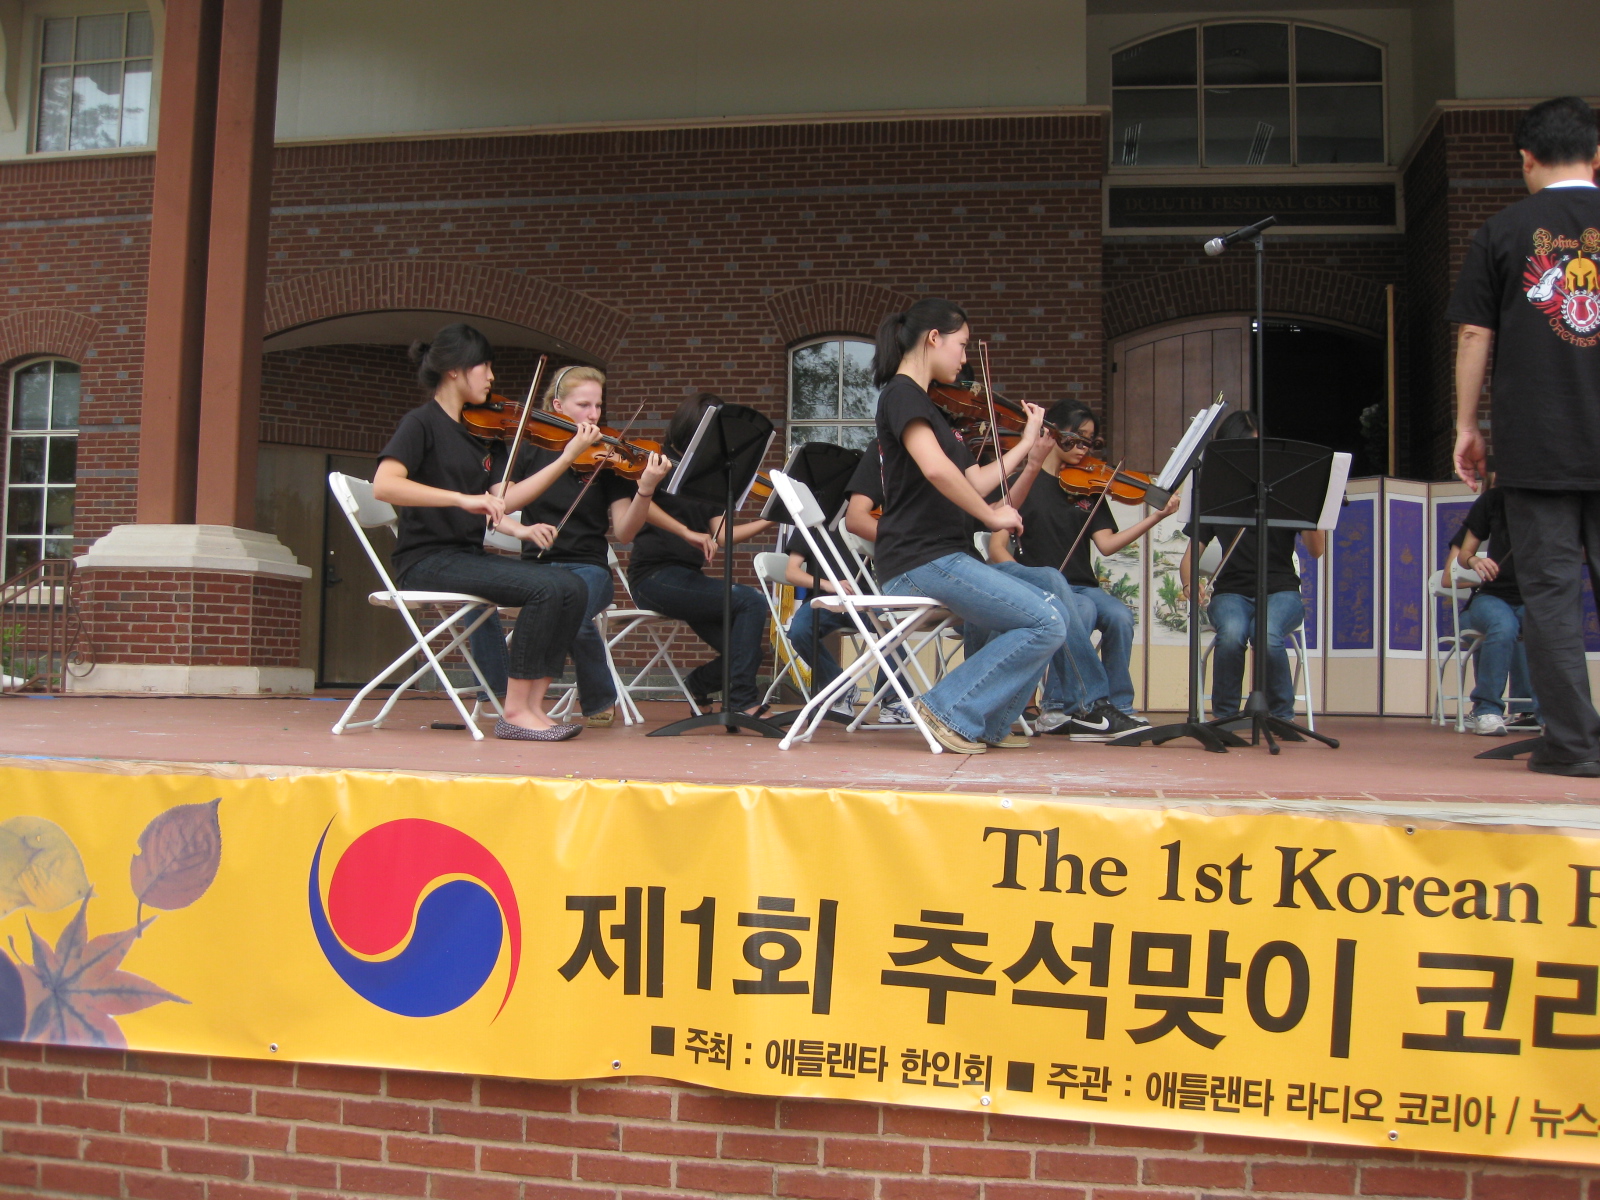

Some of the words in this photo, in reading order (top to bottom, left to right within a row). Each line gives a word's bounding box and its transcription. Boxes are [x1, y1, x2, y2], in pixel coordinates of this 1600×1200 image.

[1125, 196, 1204, 211] DULUTH
[1211, 195, 1297, 210] FESTIVAL
[1303, 195, 1380, 209] CENTER
[983, 826, 1128, 897] The
[1158, 840, 1253, 905] 1st
[1272, 846, 1543, 925] Korean
[557, 886, 839, 1015] 제1회
[881, 909, 1358, 1059] 추석맞이
[684, 1027, 733, 1071] 주최
[765, 1039, 889, 1082] 애틀랜타
[900, 1048, 993, 1092] 한인회
[1046, 1062, 1113, 1102] 주관
[1145, 1071, 1275, 1117] 애틀랜타
[1286, 1082, 1384, 1124] 라디오
[1394, 1092, 1496, 1134] 코리아
[1530, 1099, 1600, 1139] 뉴스
